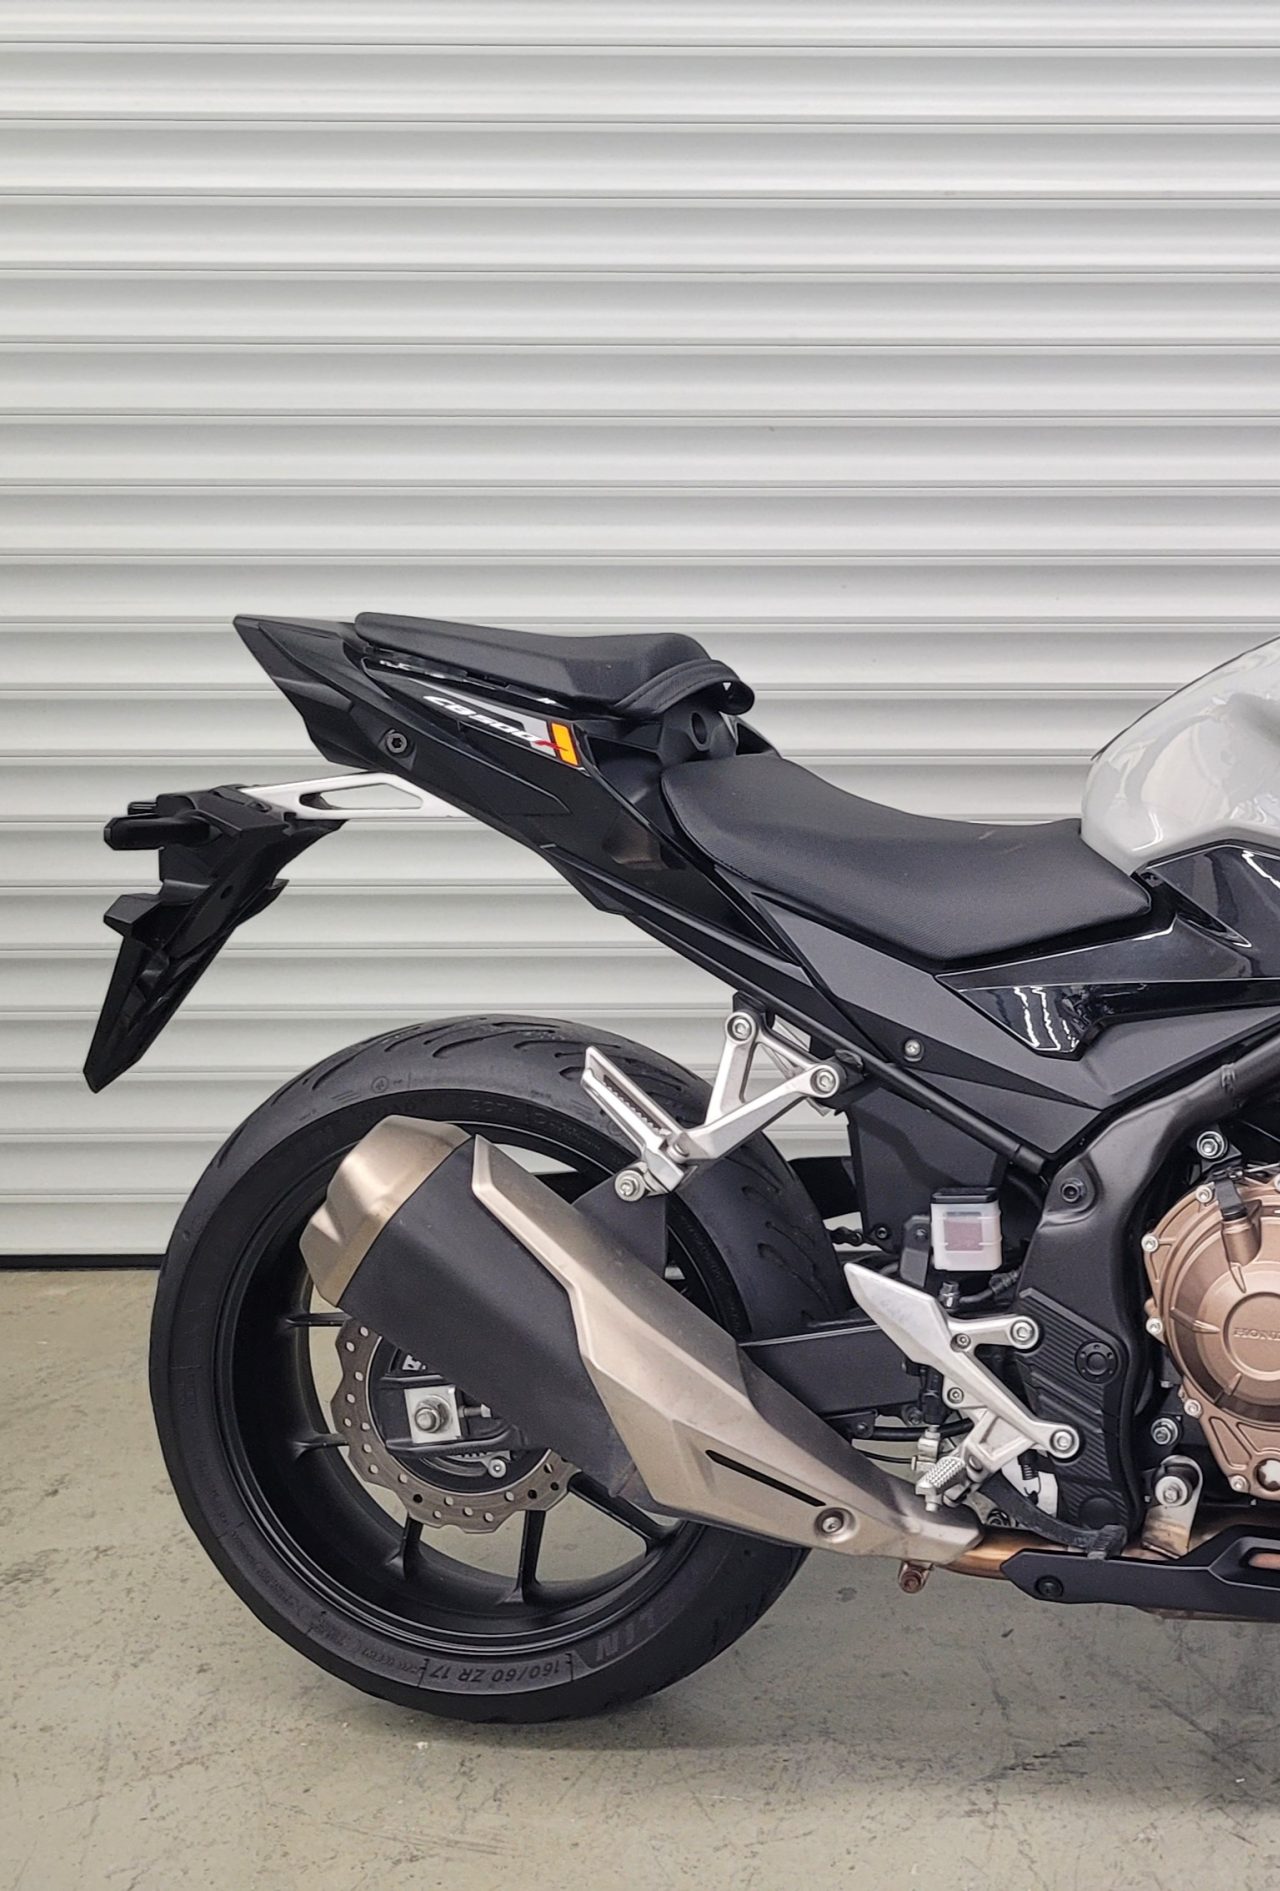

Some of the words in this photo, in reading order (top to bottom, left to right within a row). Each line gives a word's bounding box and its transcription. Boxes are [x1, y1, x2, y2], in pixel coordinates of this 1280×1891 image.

[429, 1665, 449, 1680] 17
[458, 1667, 486, 1683] ZR
[492, 1659, 560, 1683] 160/60
